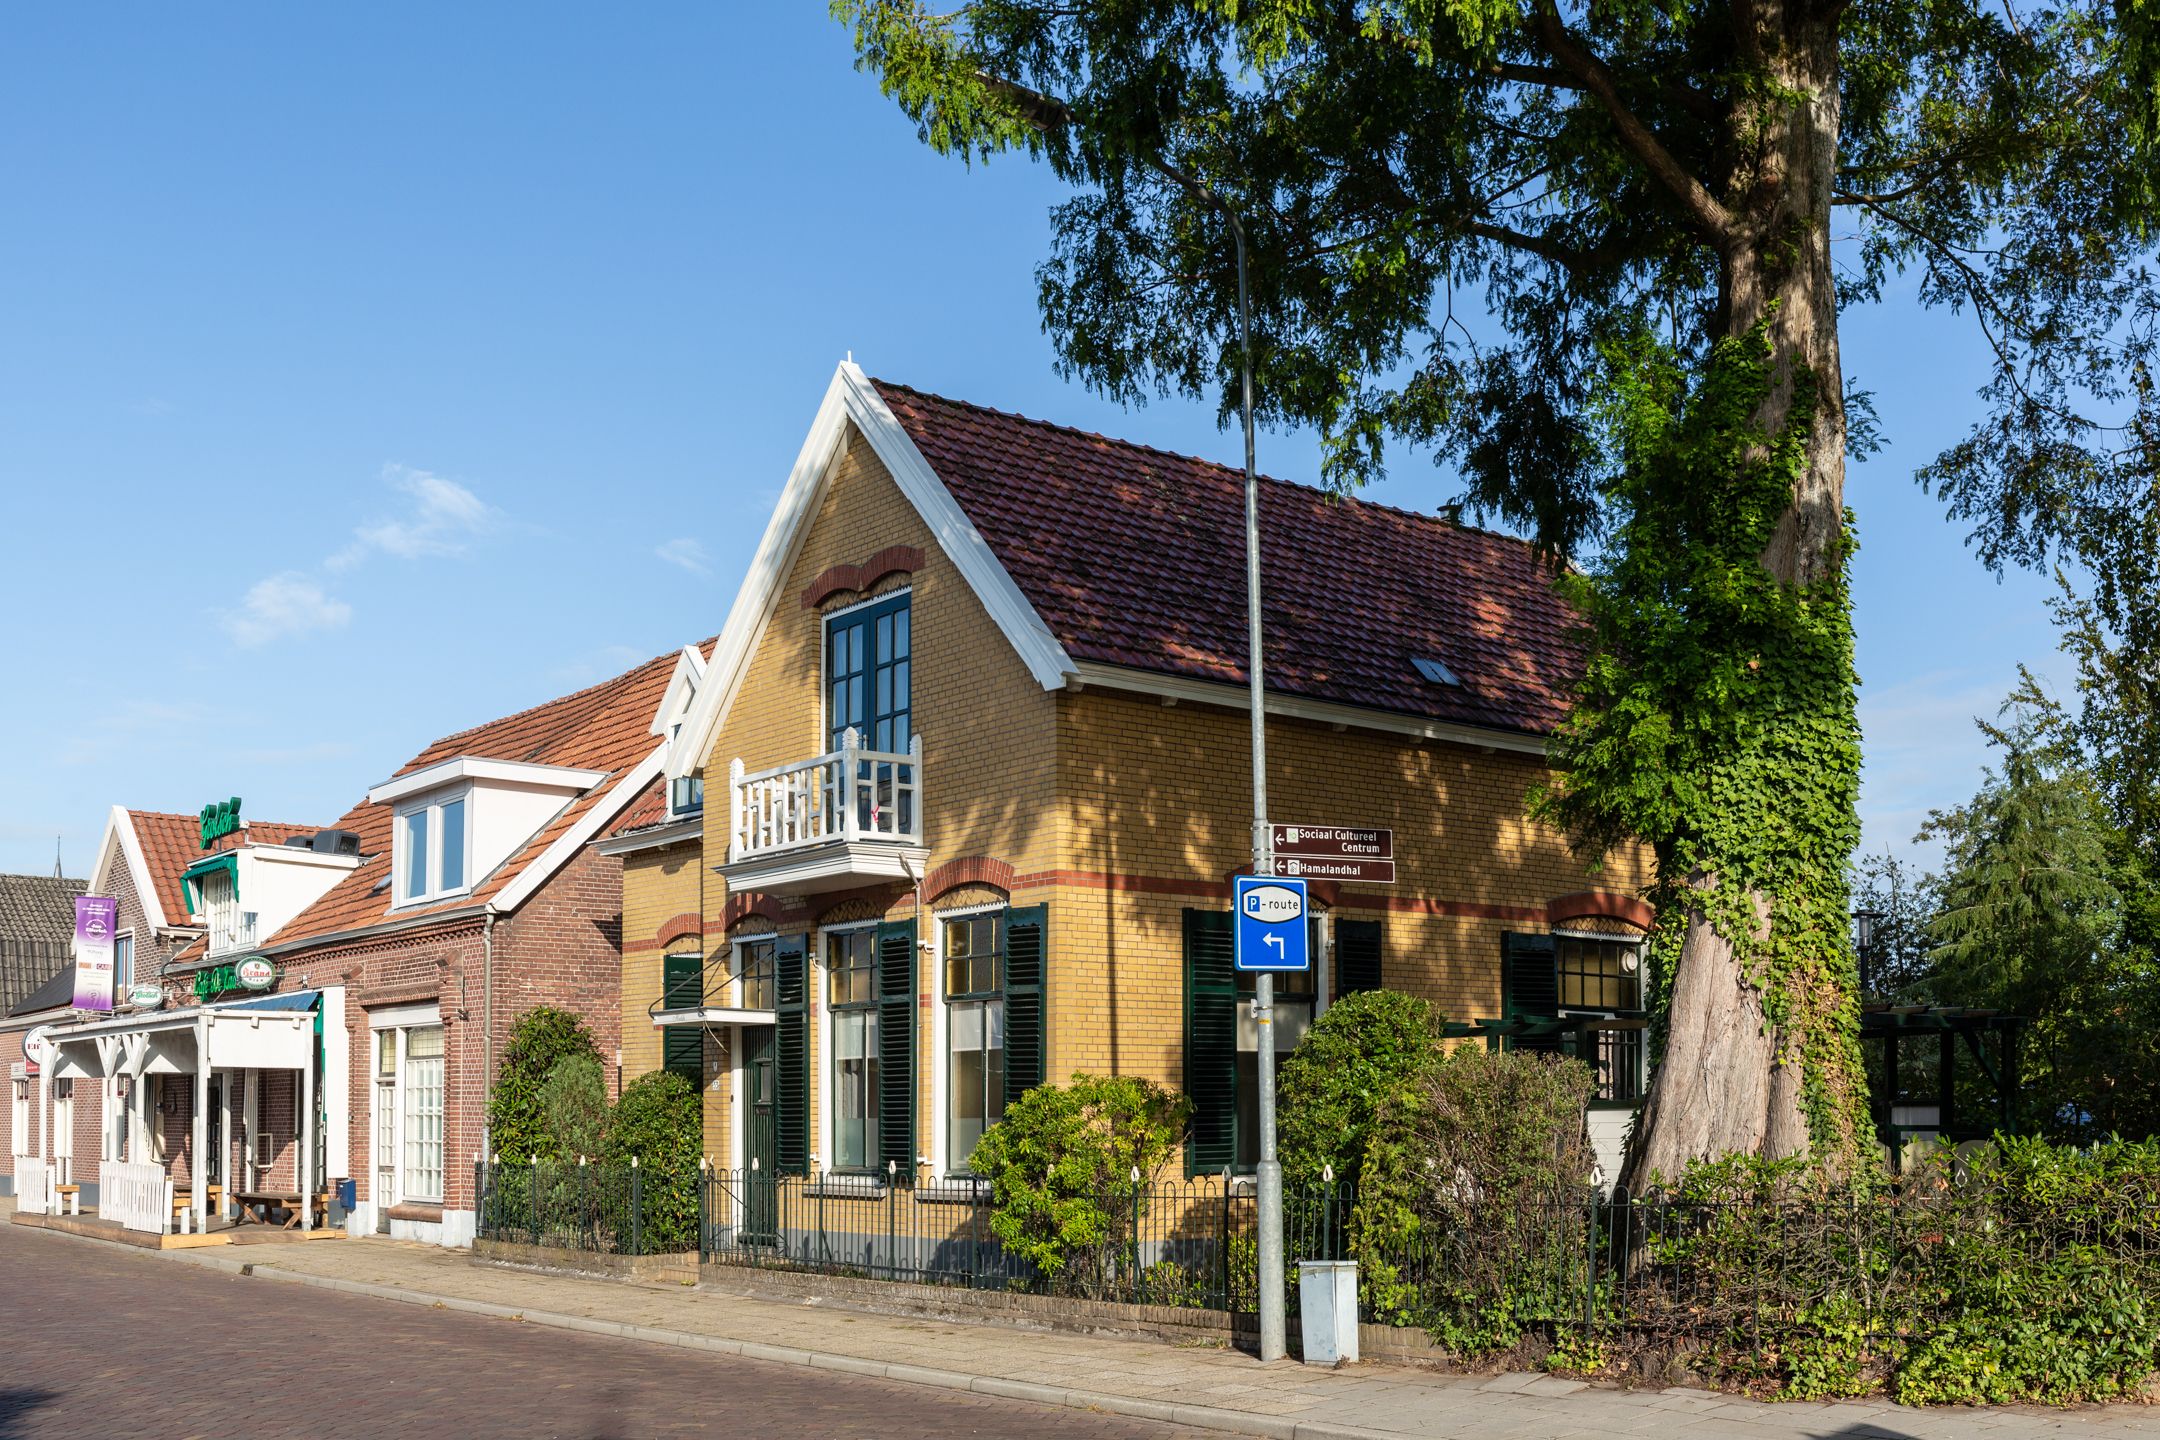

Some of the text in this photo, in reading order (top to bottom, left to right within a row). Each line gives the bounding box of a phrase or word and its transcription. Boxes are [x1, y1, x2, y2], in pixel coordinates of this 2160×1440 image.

[1299, 829, 1377, 842] Sociaal Cultureel
[1341, 842, 1380, 854] Centrum
[1300, 862, 1361, 876] Hamalandhal
